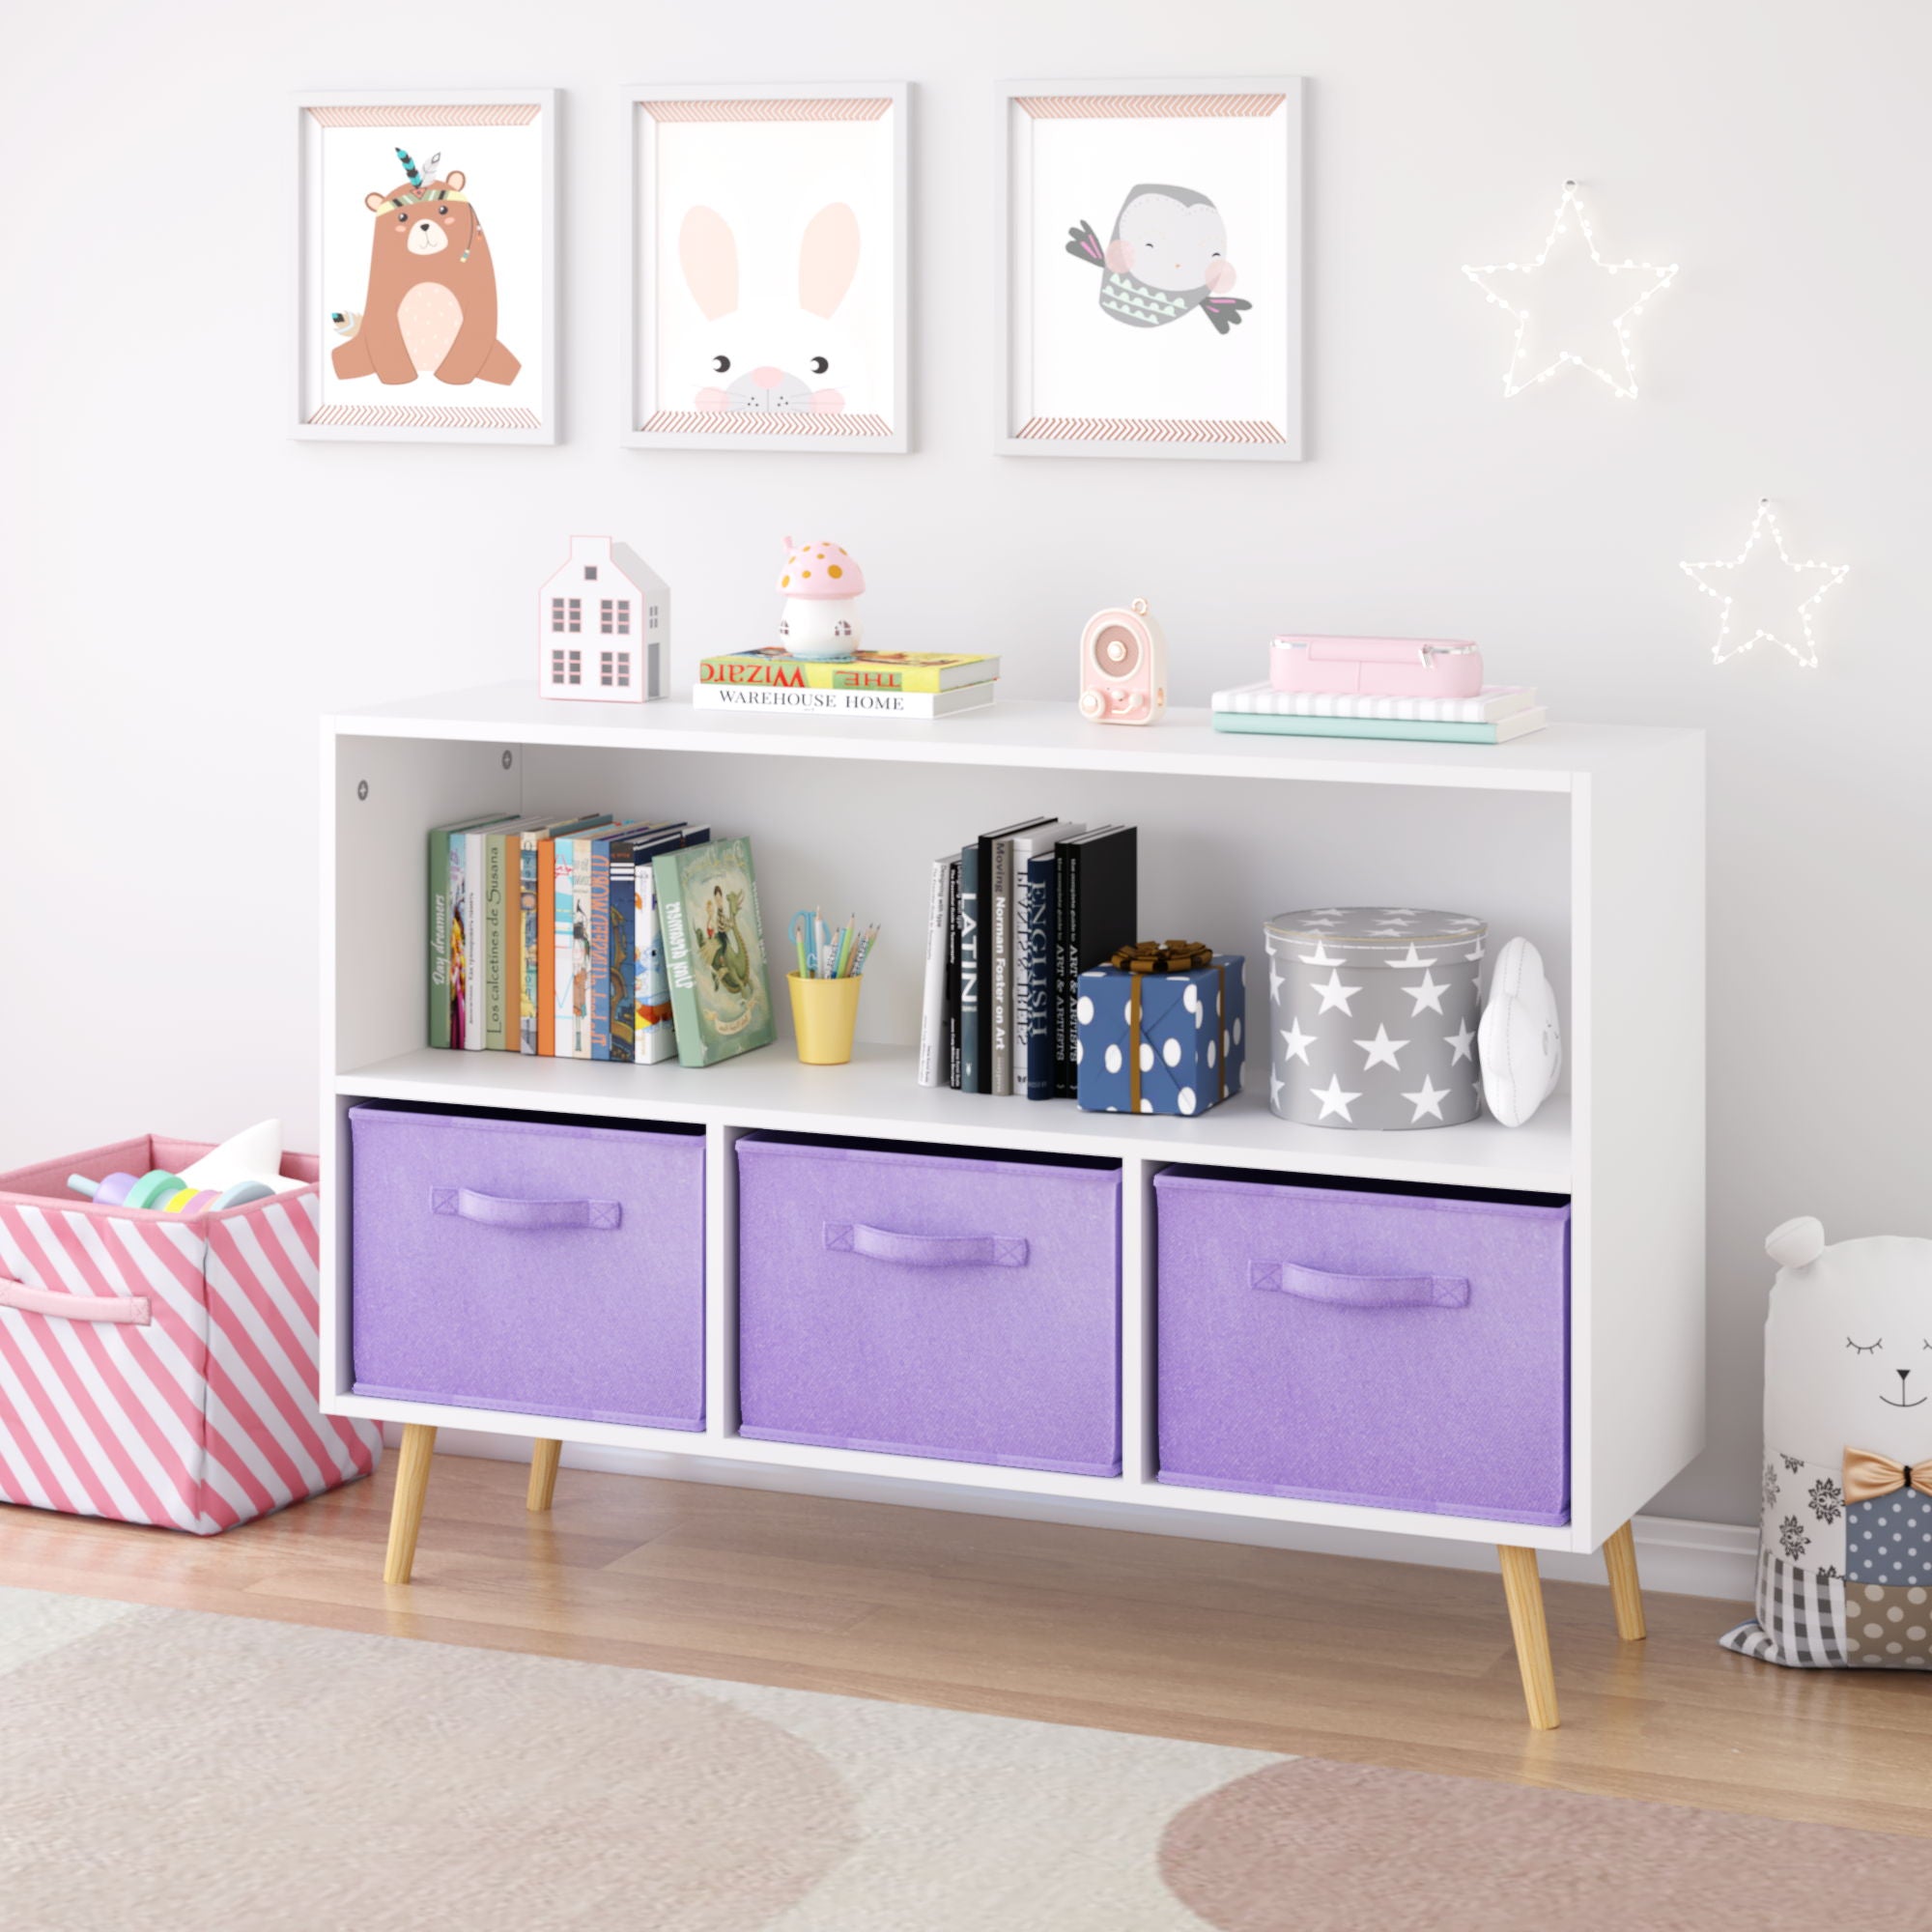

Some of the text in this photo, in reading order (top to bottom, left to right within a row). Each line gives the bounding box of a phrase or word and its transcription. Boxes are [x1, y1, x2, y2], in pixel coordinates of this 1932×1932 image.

[720, 690, 904, 711] WAREHOUSE HOME
[837, 671, 901, 689] THE
[431, 895, 449, 985] Day dreamers
[487, 847, 501, 1034] Los calcetines de Susana
[995, 842, 1007, 1050] Moving Norman Foster on Art
[1032, 880, 1047, 1037] ENGLISH
[1069, 945, 1078, 977] ART
